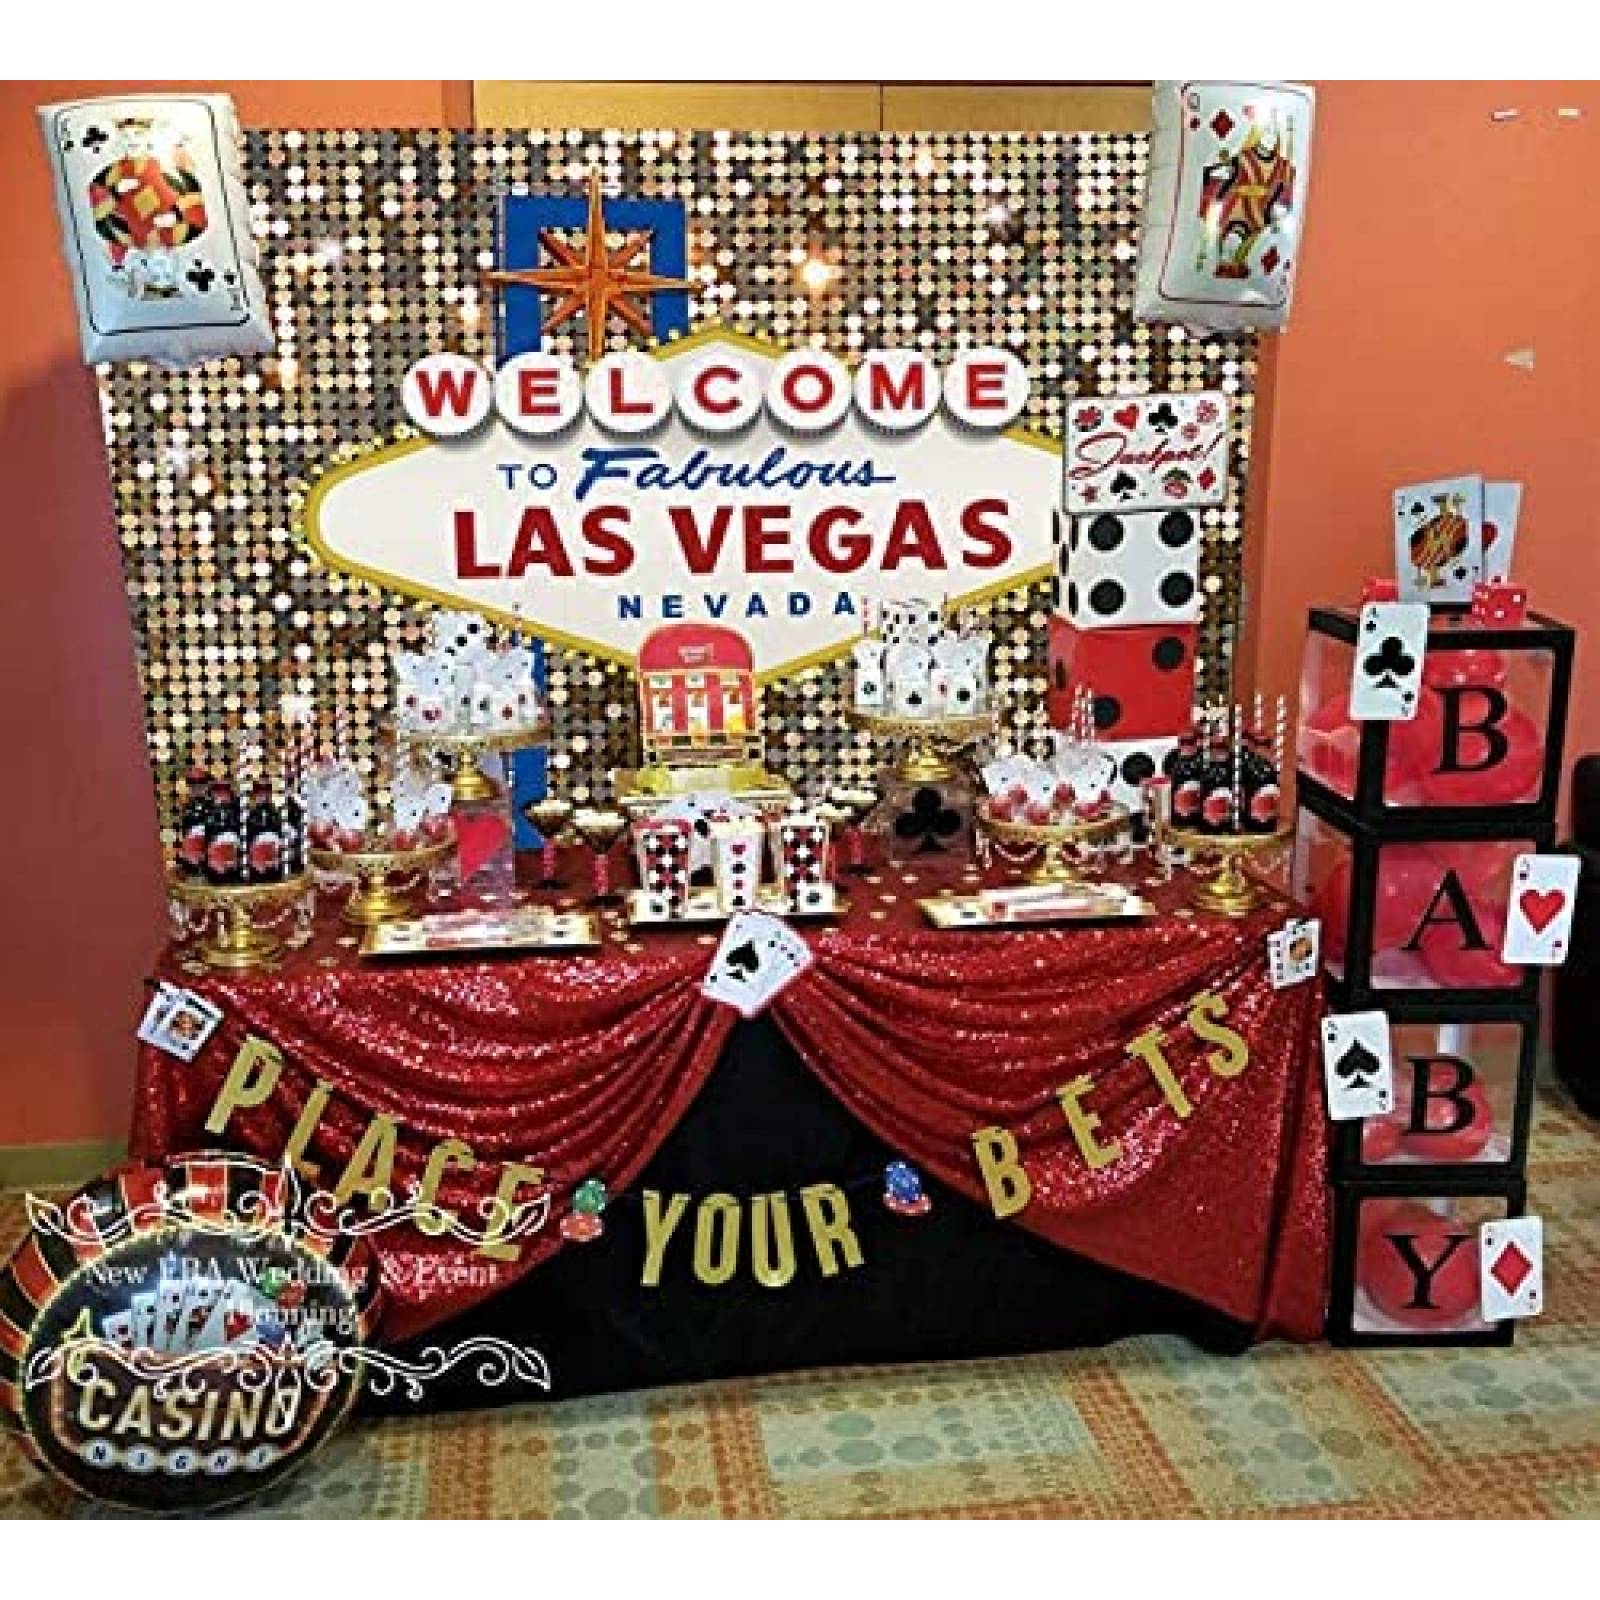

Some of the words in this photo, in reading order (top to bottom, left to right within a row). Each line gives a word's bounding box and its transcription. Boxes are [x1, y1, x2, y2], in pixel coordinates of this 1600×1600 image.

[416, 361, 1008, 418] WELCOME
[498, 463, 557, 488] TO
[576, 447, 897, 499] Fabulous
[454, 505, 636, 579] LAS
[668, 499, 1014, 575] VEGAS
[617, 591, 855, 619] NEVADA
[204, 1033, 545, 1262] PLACE
[640, 1182, 865, 1288] YOUR
[970, 989, 1249, 1219] BETS
[77, 1375, 301, 1441] CASINO
